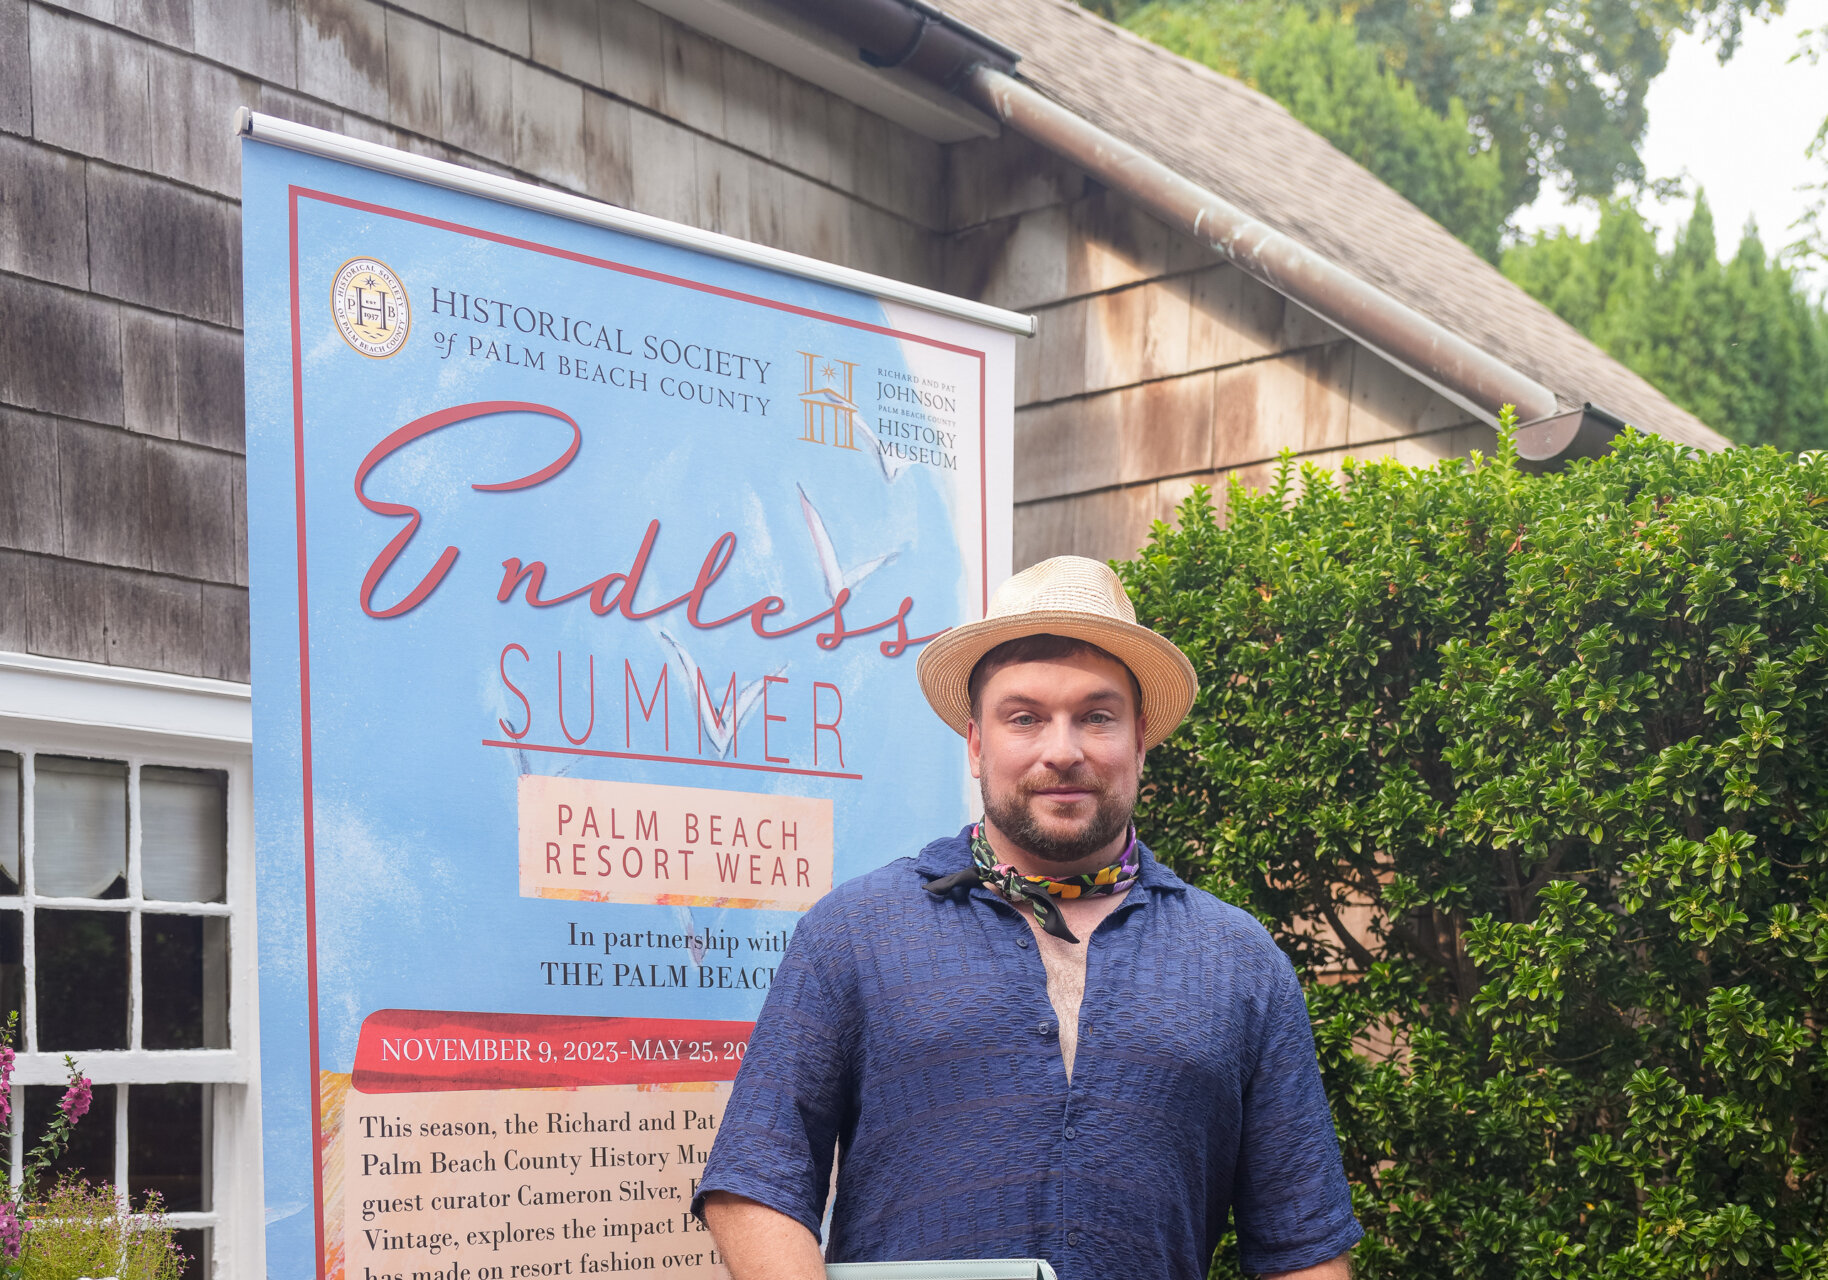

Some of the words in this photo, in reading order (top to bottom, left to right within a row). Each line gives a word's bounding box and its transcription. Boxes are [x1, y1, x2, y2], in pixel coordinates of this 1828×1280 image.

[338, 264, 375, 297] HISTORICAL
[379, 270, 404, 308] SOCIETY
[342, 321, 360, 344] PALM
[359, 341, 386, 353] BEACH
[386, 320, 405, 349] COUNTY
[431, 286, 633, 357] HISTORICAL
[643, 334, 772, 385] SOCIETY
[433, 330, 458, 360] of
[468, 335, 546, 371] PALM
[558, 355, 648, 393] BEACH
[659, 376, 772, 417] COUNTY
[877, 368, 920, 385] RICHARD
[921, 378, 940, 389] AND
[941, 383, 956, 394] PAT
[876, 382, 957, 414] JOHNSON
[878, 404, 899, 415] PALM
[901, 408, 926, 420] BEACH
[927, 414, 957, 427] COUNTY
[878, 418, 957, 449] HISTORY
[878, 439, 958, 471] MUSEUM
[353, 400, 954, 659] Endless
[499, 643, 845, 769] SUMMER
[557, 803, 660, 842] PALM
[685, 812, 799, 852] BEACH
[545, 841, 694, 881] RESORT
[716, 852, 811, 888] WEAR
[567, 921, 595, 948] In
[603, 926, 740, 959] partnership
[540, 961, 603, 987] THE
[612, 963, 688, 989] PALM
[380, 1038, 533, 1062] NOVEMBER
[538, 1041, 559, 1064] 9,
[688, 1040, 718, 1063] 25,
[359, 1115, 413, 1139] This
[419, 1119, 498, 1141] season,
[504, 1113, 539, 1135] the
[545, 1110, 632, 1134] Richard
[638, 1109, 676, 1131] and
[682, 1109, 716, 1130] Pat
[361, 1152, 423, 1176] Palm
[430, 1150, 497, 1174] Beach
[504, 1148, 582, 1175] County
[589, 1145, 671, 1172] History
[361, 1195, 424, 1222] guest
[430, 1190, 512, 1213] curator
[516, 1183, 613, 1208] Cameron
[618, 1179, 683, 1204] Silver,
[362, 1227, 461, 1255] Vintage,
[466, 1221, 556, 1252] explores
[562, 1218, 597, 1240] the
[602, 1216, 675, 1245] impact
[681, 1212, 711, 1233] Pa
[509, 1257, 574, 1280] resort
[578, 1250, 656, 1275] fashion
[661, 1251, 704, 1269] over
